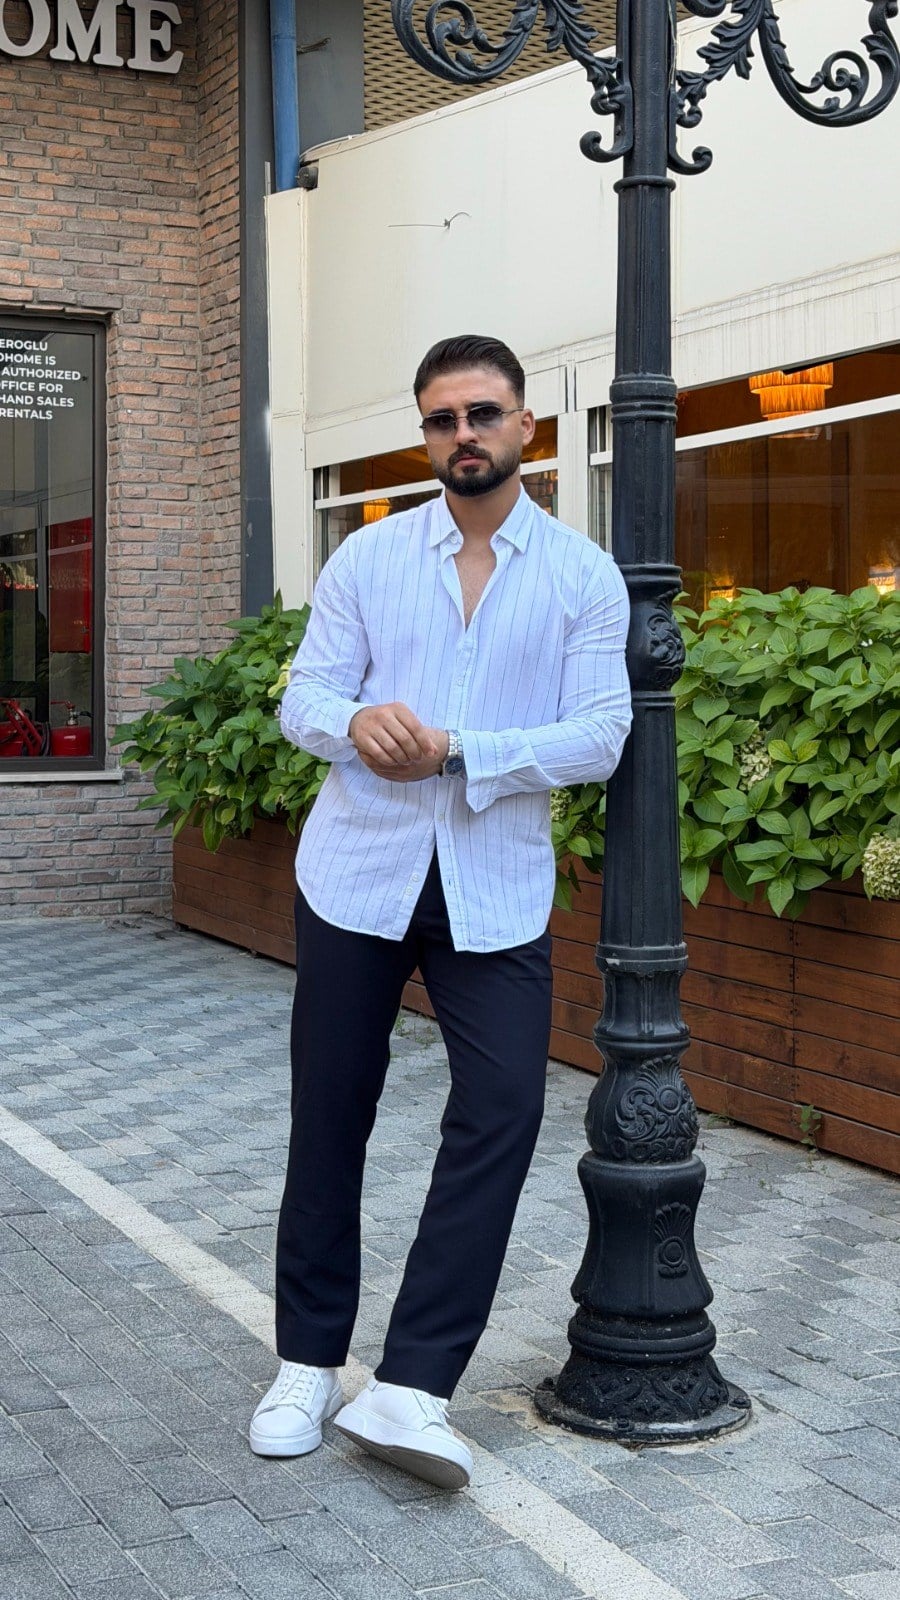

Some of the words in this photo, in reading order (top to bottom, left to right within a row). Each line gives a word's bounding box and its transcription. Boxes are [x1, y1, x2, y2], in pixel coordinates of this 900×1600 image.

[0, 0, 183, 74] OME
[0, 339, 48, 351] EROGLU
[45, 356, 56, 365] IS
[1, 367, 81, 380] AUTHORIZED
[0, 381, 35, 391] FFICE
[39, 383, 63, 393] FOR
[37, 396, 74, 407] SALES
[0, 408, 53, 420] RENTALS
